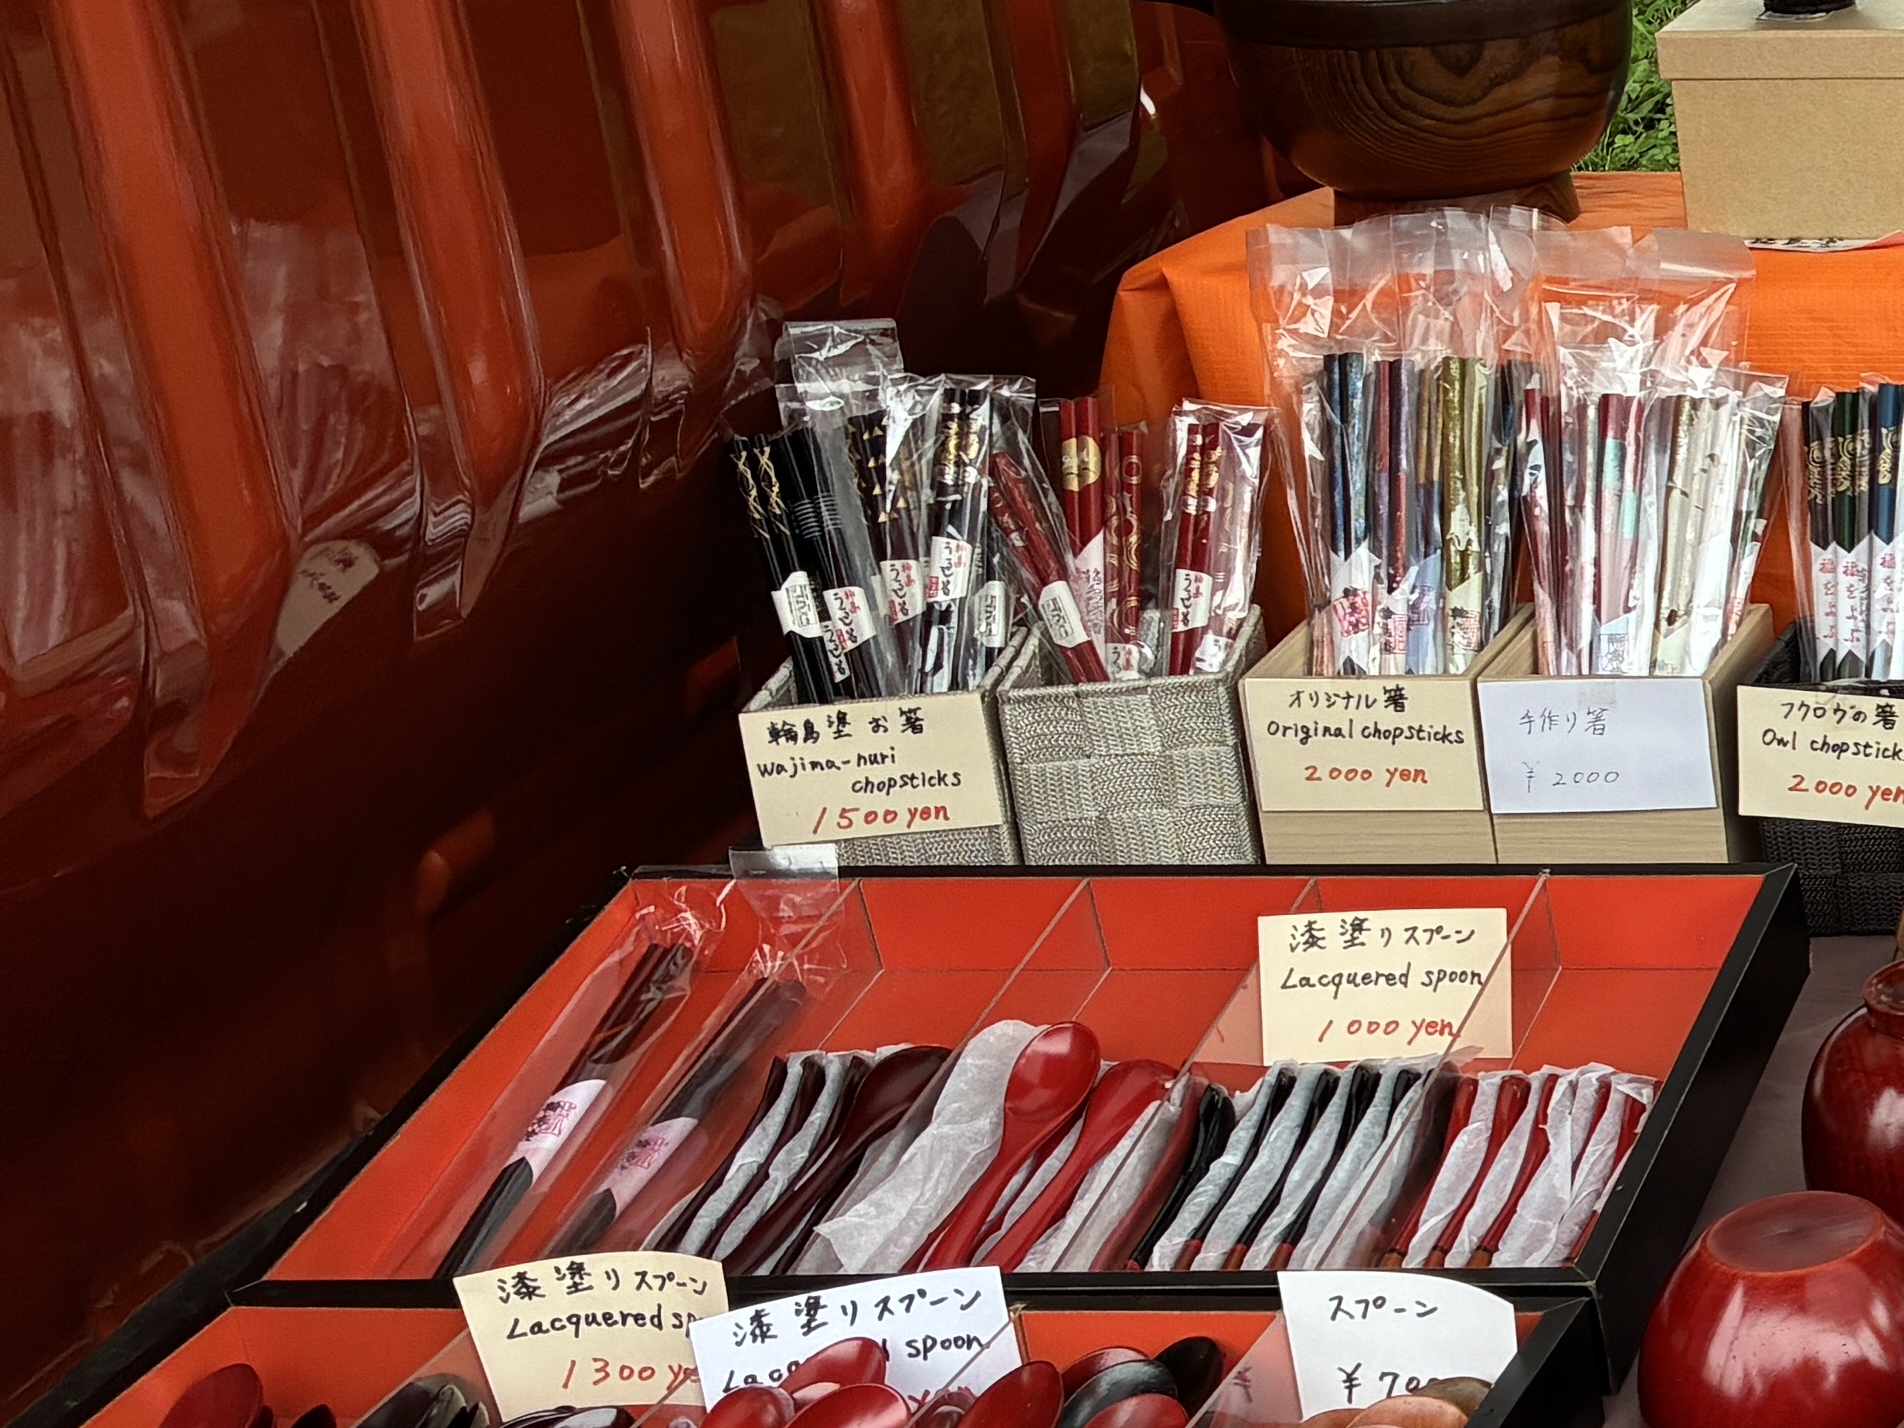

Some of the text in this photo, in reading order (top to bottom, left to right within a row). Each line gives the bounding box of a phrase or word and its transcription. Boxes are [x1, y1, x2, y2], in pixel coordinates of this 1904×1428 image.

[1267, 719, 1466, 746] Original chopsticks
[1518, 707, 1612, 739] 手作り箸
[1761, 728, 1798, 751] Owl
[757, 747, 897, 778] wajima-nuri
[1304, 764, 1429, 788] 2000 yen
[851, 770, 962, 796] chopsticks
[1787, 774, 1858, 799] 2000
[1289, 916, 1475, 953] 漆塗りスプーン
[1280, 962, 1486, 1000] Lacquered spoon
[1318, 1018, 1461, 1046] 1000 yen
[496, 1260, 708, 1304] 漆塗りスプーン
[507, 1303, 663, 1340] Lacquered
[732, 1288, 981, 1347] 漆塗りスプーン
[1328, 1294, 1439, 1322] スプーン
[905, 1335, 985, 1361] spoon
[562, 1357, 656, 1390] 1300
